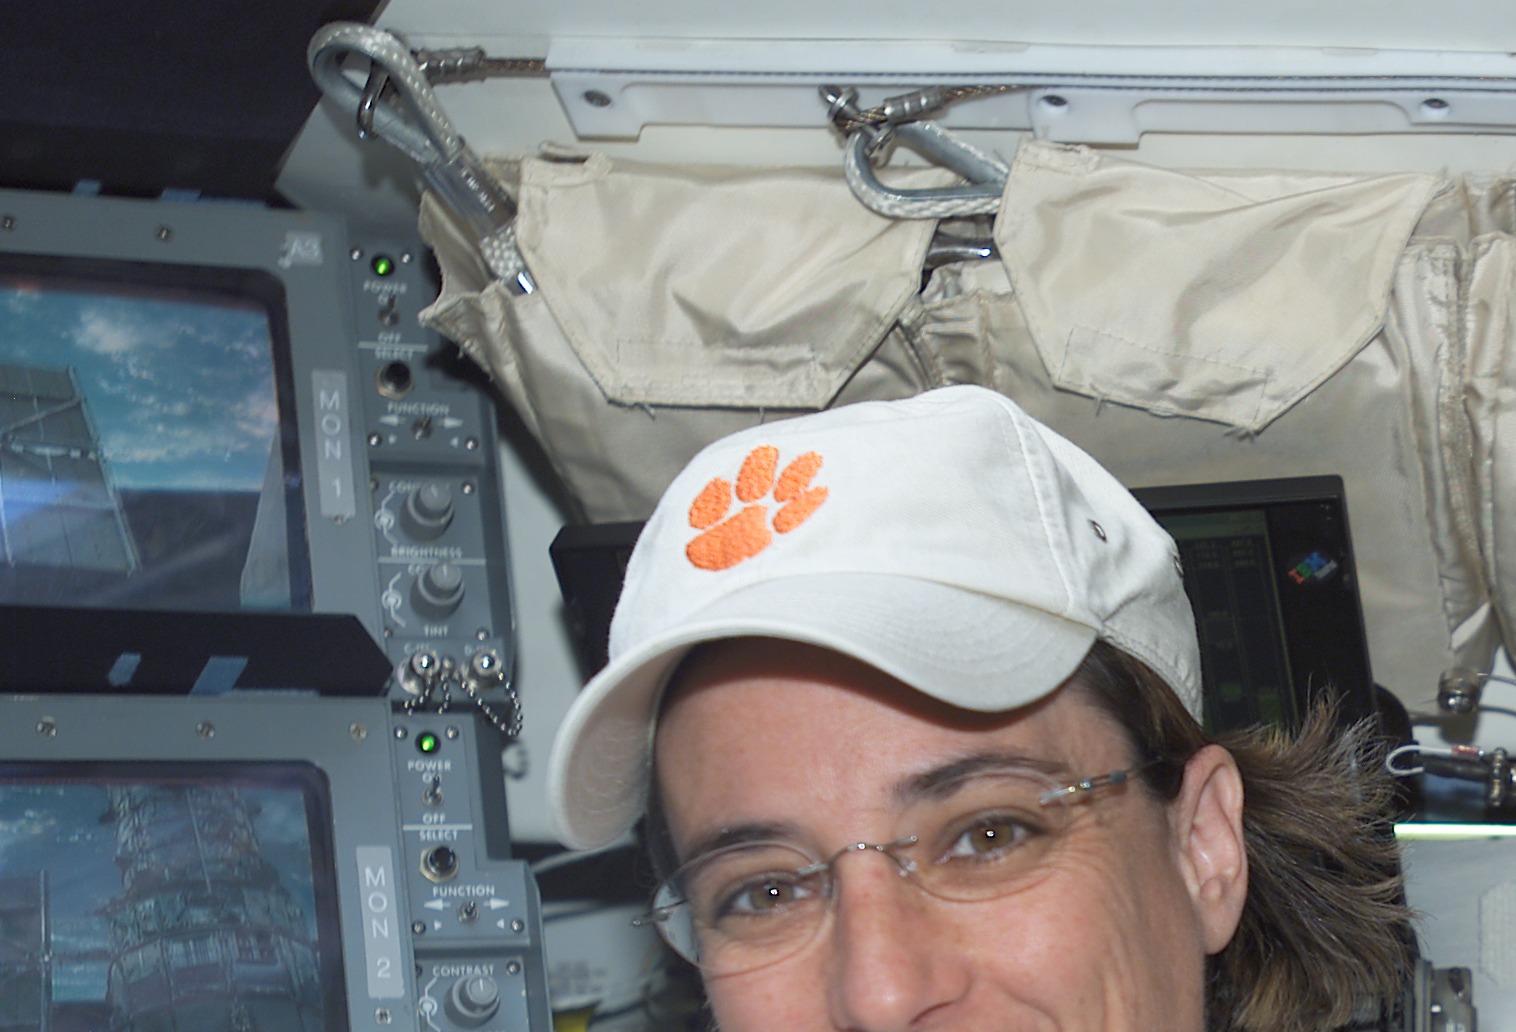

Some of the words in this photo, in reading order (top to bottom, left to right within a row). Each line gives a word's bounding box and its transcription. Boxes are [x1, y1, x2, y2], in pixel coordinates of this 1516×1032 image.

[319, 390, 341, 460] MON
[331, 477, 341, 498] 1
[407, 760, 451, 771] POWER
[422, 813, 446, 824] OFF
[419, 830, 458, 841] SELECT
[432, 884, 495, 897] FUNCTION
[365, 867, 389, 939] MON
[377, 957, 391, 979] 2
[432, 964, 495, 977] CONTRAST
